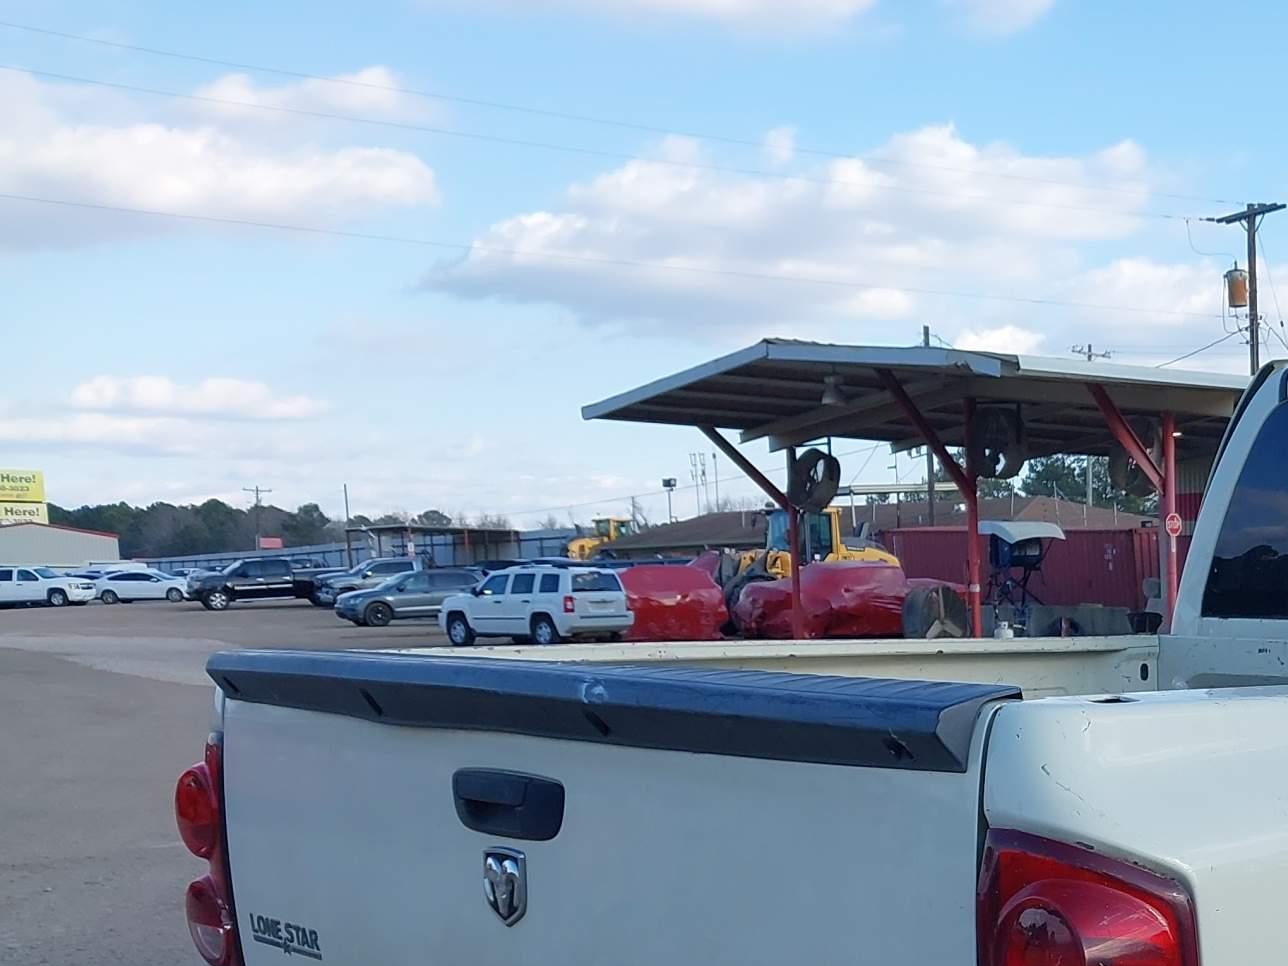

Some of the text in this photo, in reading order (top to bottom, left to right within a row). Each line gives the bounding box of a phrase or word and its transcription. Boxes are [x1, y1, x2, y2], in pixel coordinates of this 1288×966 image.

[0, 473, 36, 484] Here!
[4, 506, 40, 517] Here!
[249, 912, 321, 951] LONE STAR
